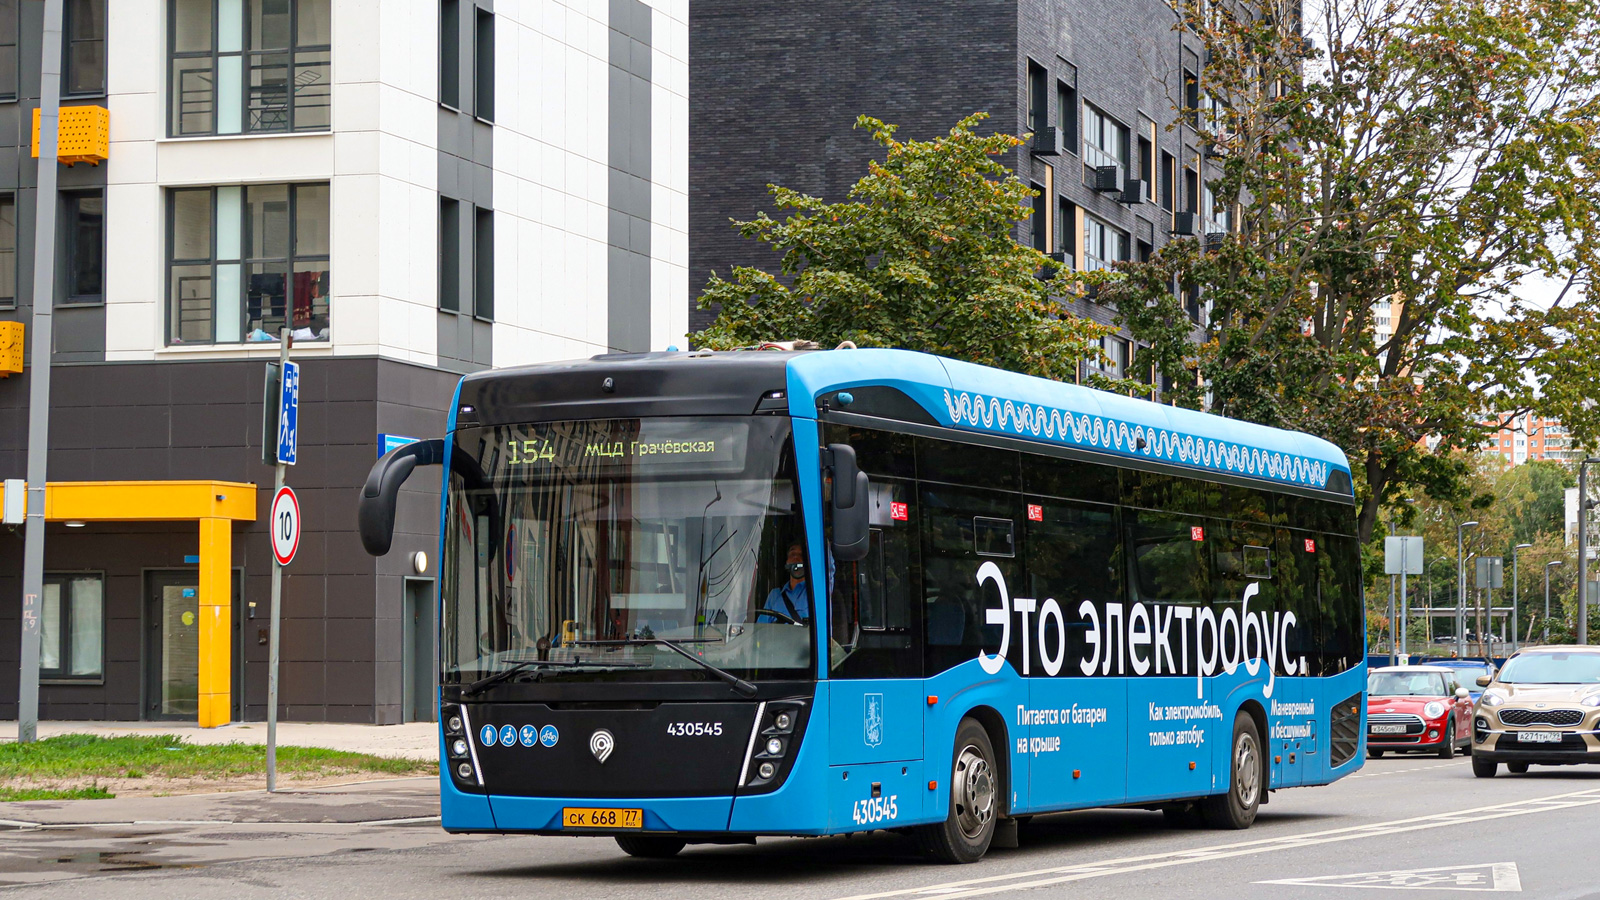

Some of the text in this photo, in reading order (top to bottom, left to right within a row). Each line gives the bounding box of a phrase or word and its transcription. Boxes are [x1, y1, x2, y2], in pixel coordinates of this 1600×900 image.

[507, 439, 715, 465] 154 МЦД Грачёвская
[279, 511, 292, 541] 10
[975, 560, 1306, 698] Это электробус.
[1016, 702, 1107, 728] Питается от батареи
[1149, 700, 1223, 724] Как электромобиль,
[1270, 698, 1315, 719] Маневренный
[666, 722, 723, 737] 430545
[1149, 724, 1205, 748] только автобус
[1270, 720, 1312, 742] и бесшумный
[1016, 736, 1061, 757] на крыше
[591, 810, 617, 825] 668
[624, 810, 638, 822] 77
[852, 794, 898, 825] 430545
